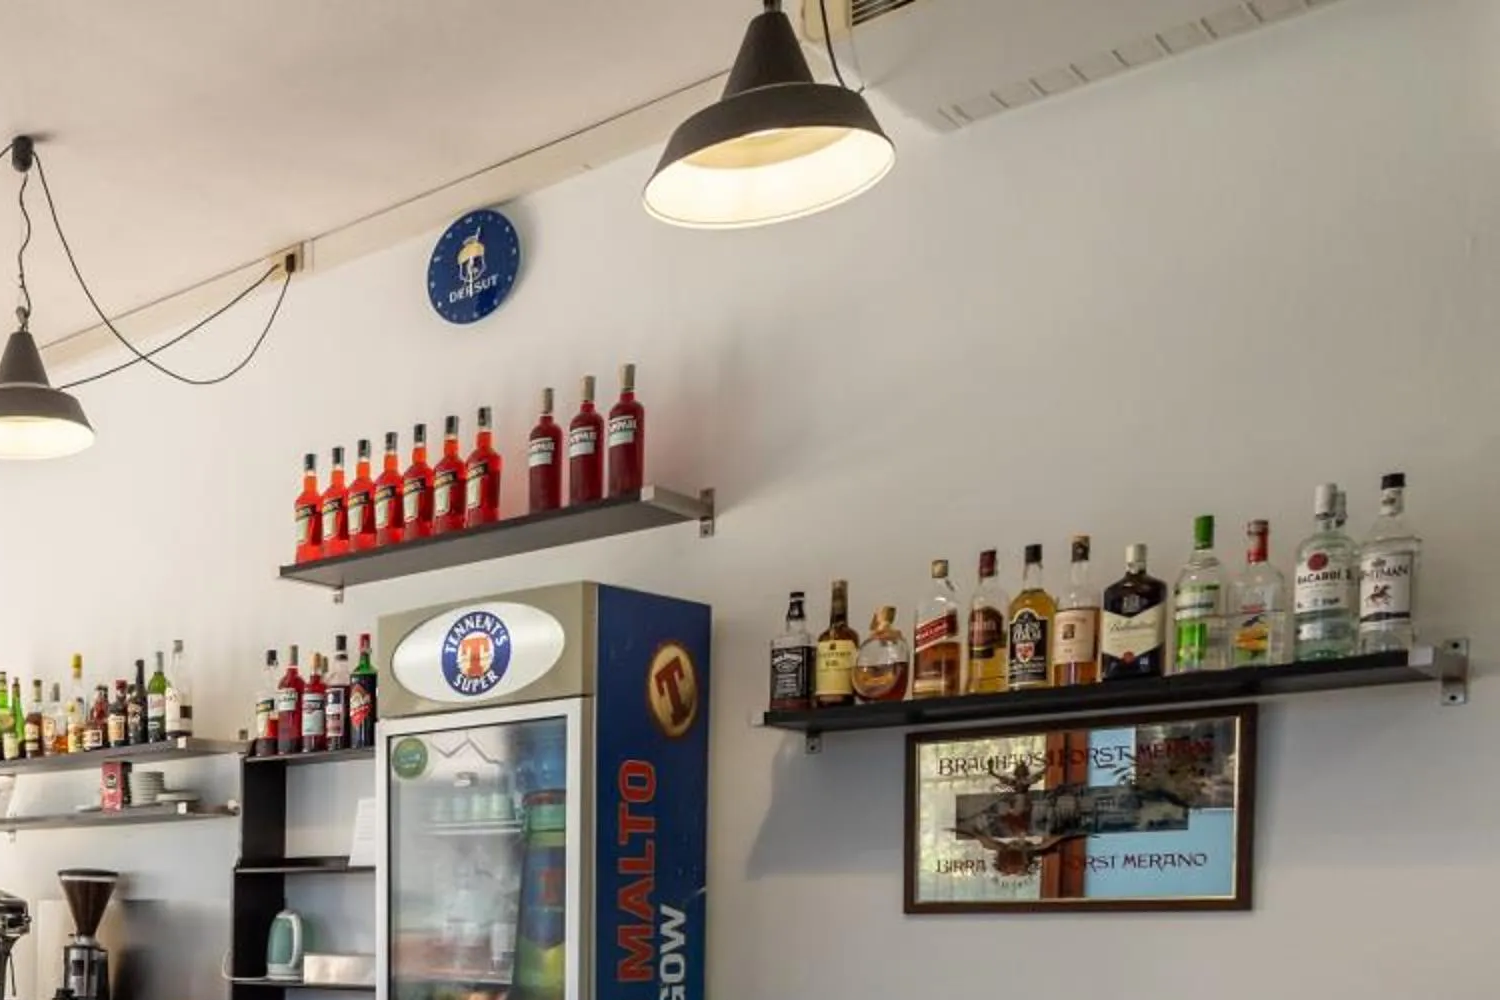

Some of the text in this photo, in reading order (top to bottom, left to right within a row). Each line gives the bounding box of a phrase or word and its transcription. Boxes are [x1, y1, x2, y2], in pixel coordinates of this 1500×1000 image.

[449, 274, 499, 303] DERSUT
[445, 613, 508, 654] TENNENT'S
[452, 670, 498, 693] SUPER
[617, 759, 657, 983] MALTO
[1123, 852, 1209, 871] MERANO
